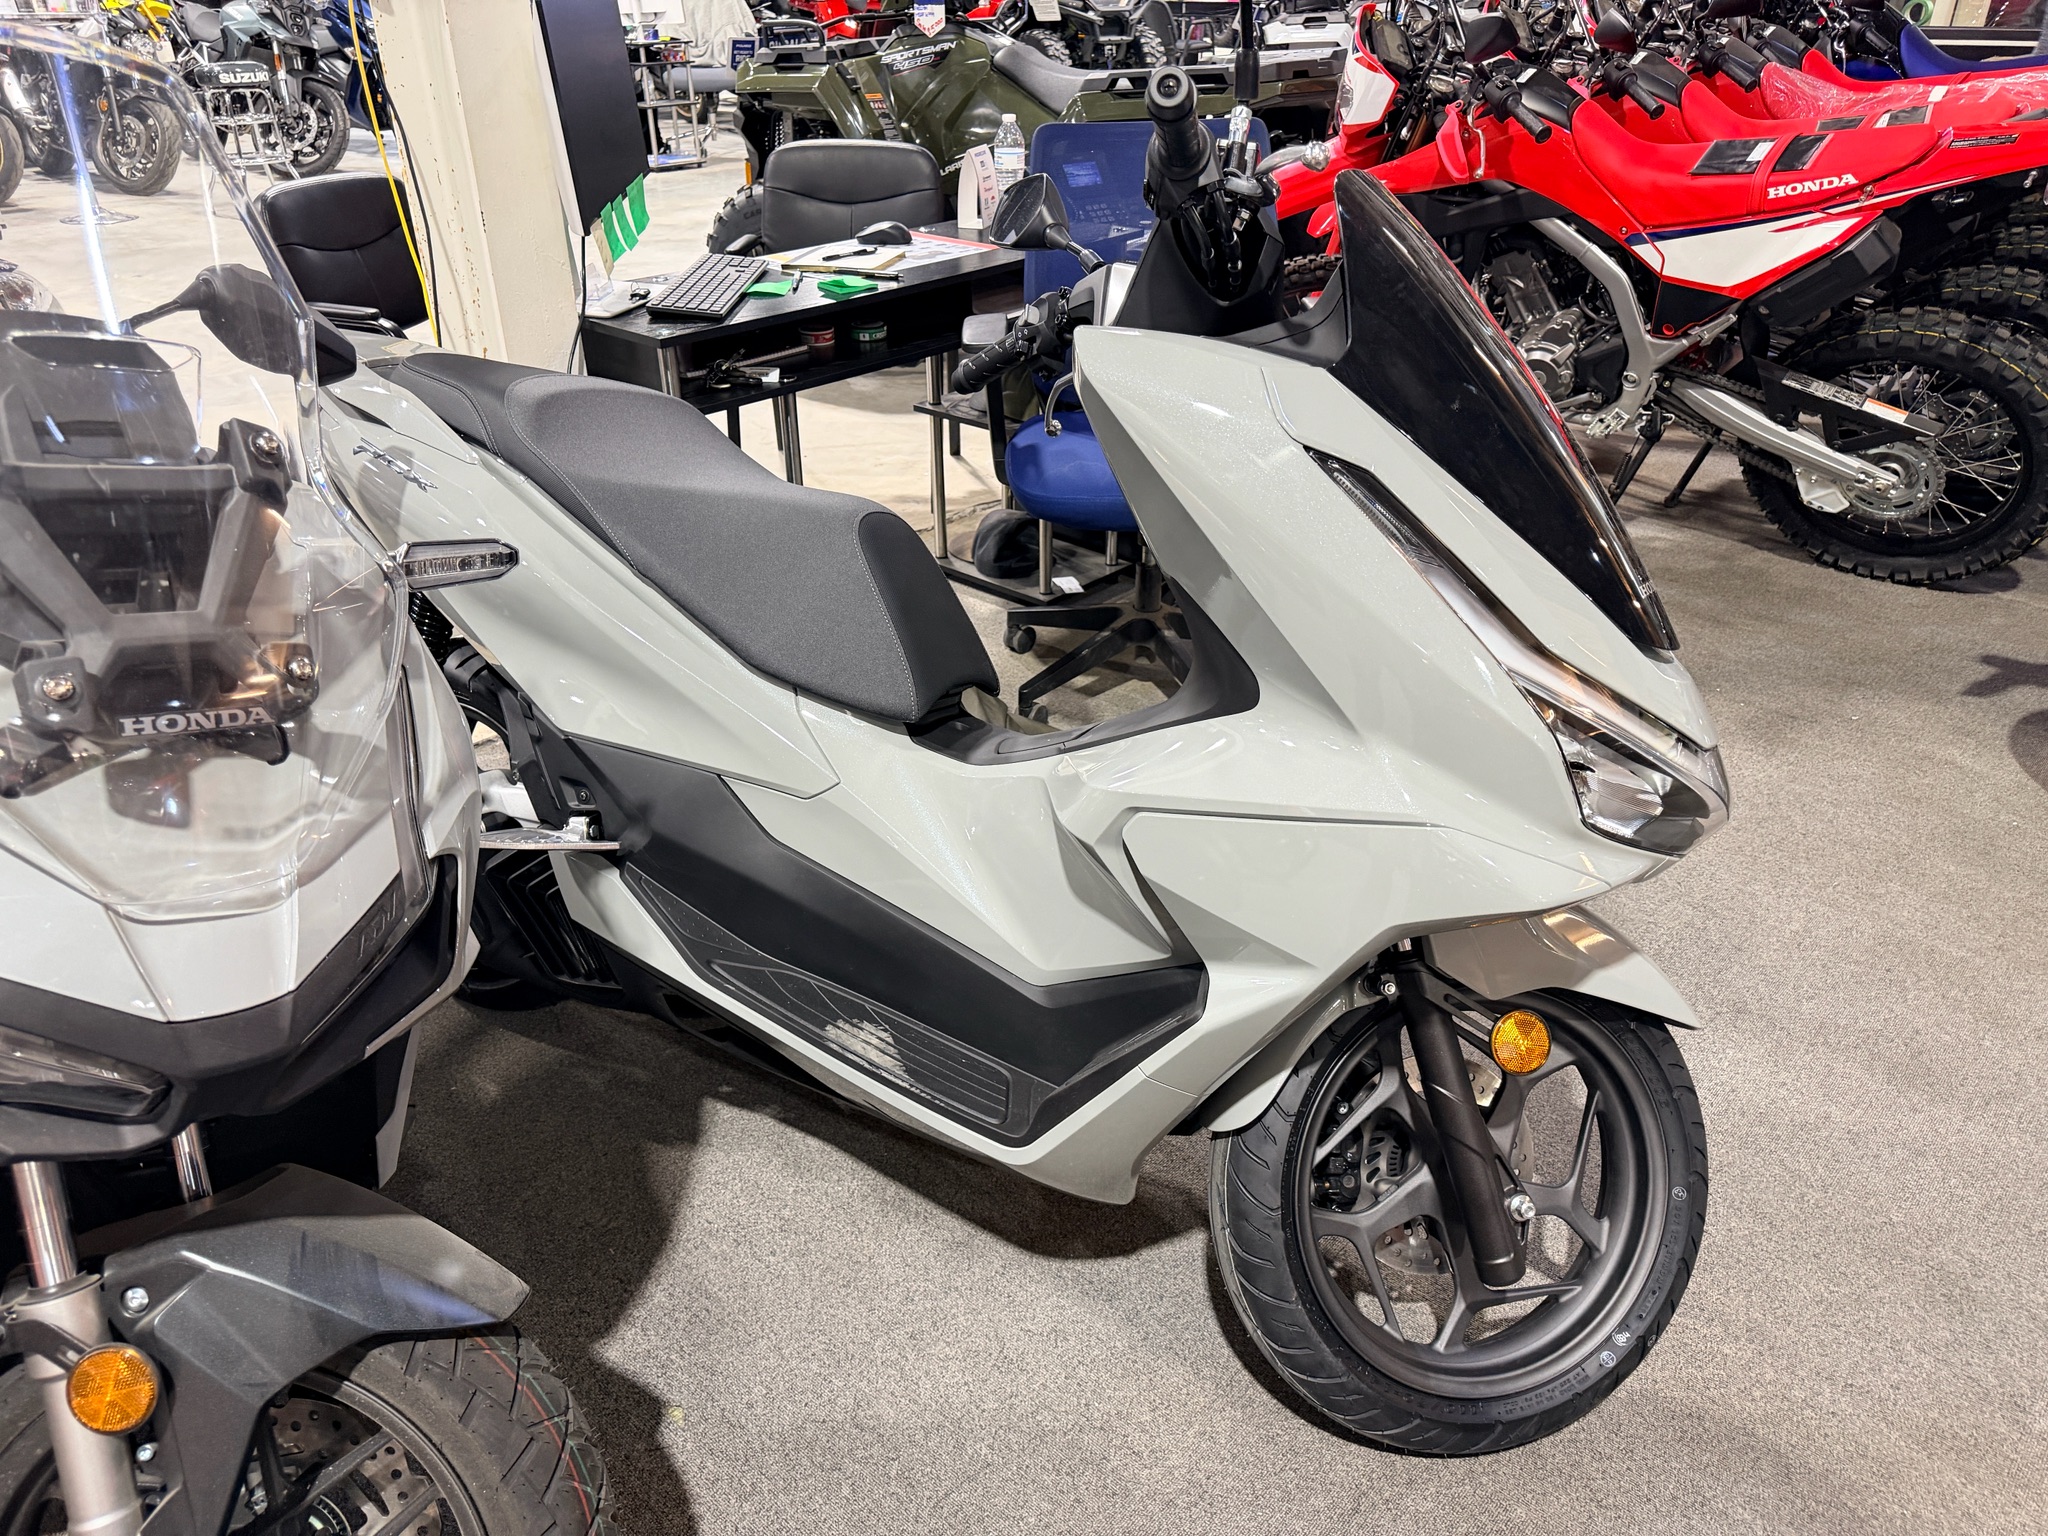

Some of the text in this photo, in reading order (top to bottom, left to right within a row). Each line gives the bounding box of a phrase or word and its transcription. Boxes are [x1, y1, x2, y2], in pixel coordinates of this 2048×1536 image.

[880, 41, 957, 63] SPORTSMAN
[893, 54, 935, 70] 450
[218, 71, 269, 84] SUZUKI
[1767, 173, 1859, 199] HONDA
[119, 706, 275, 737] HONDA
